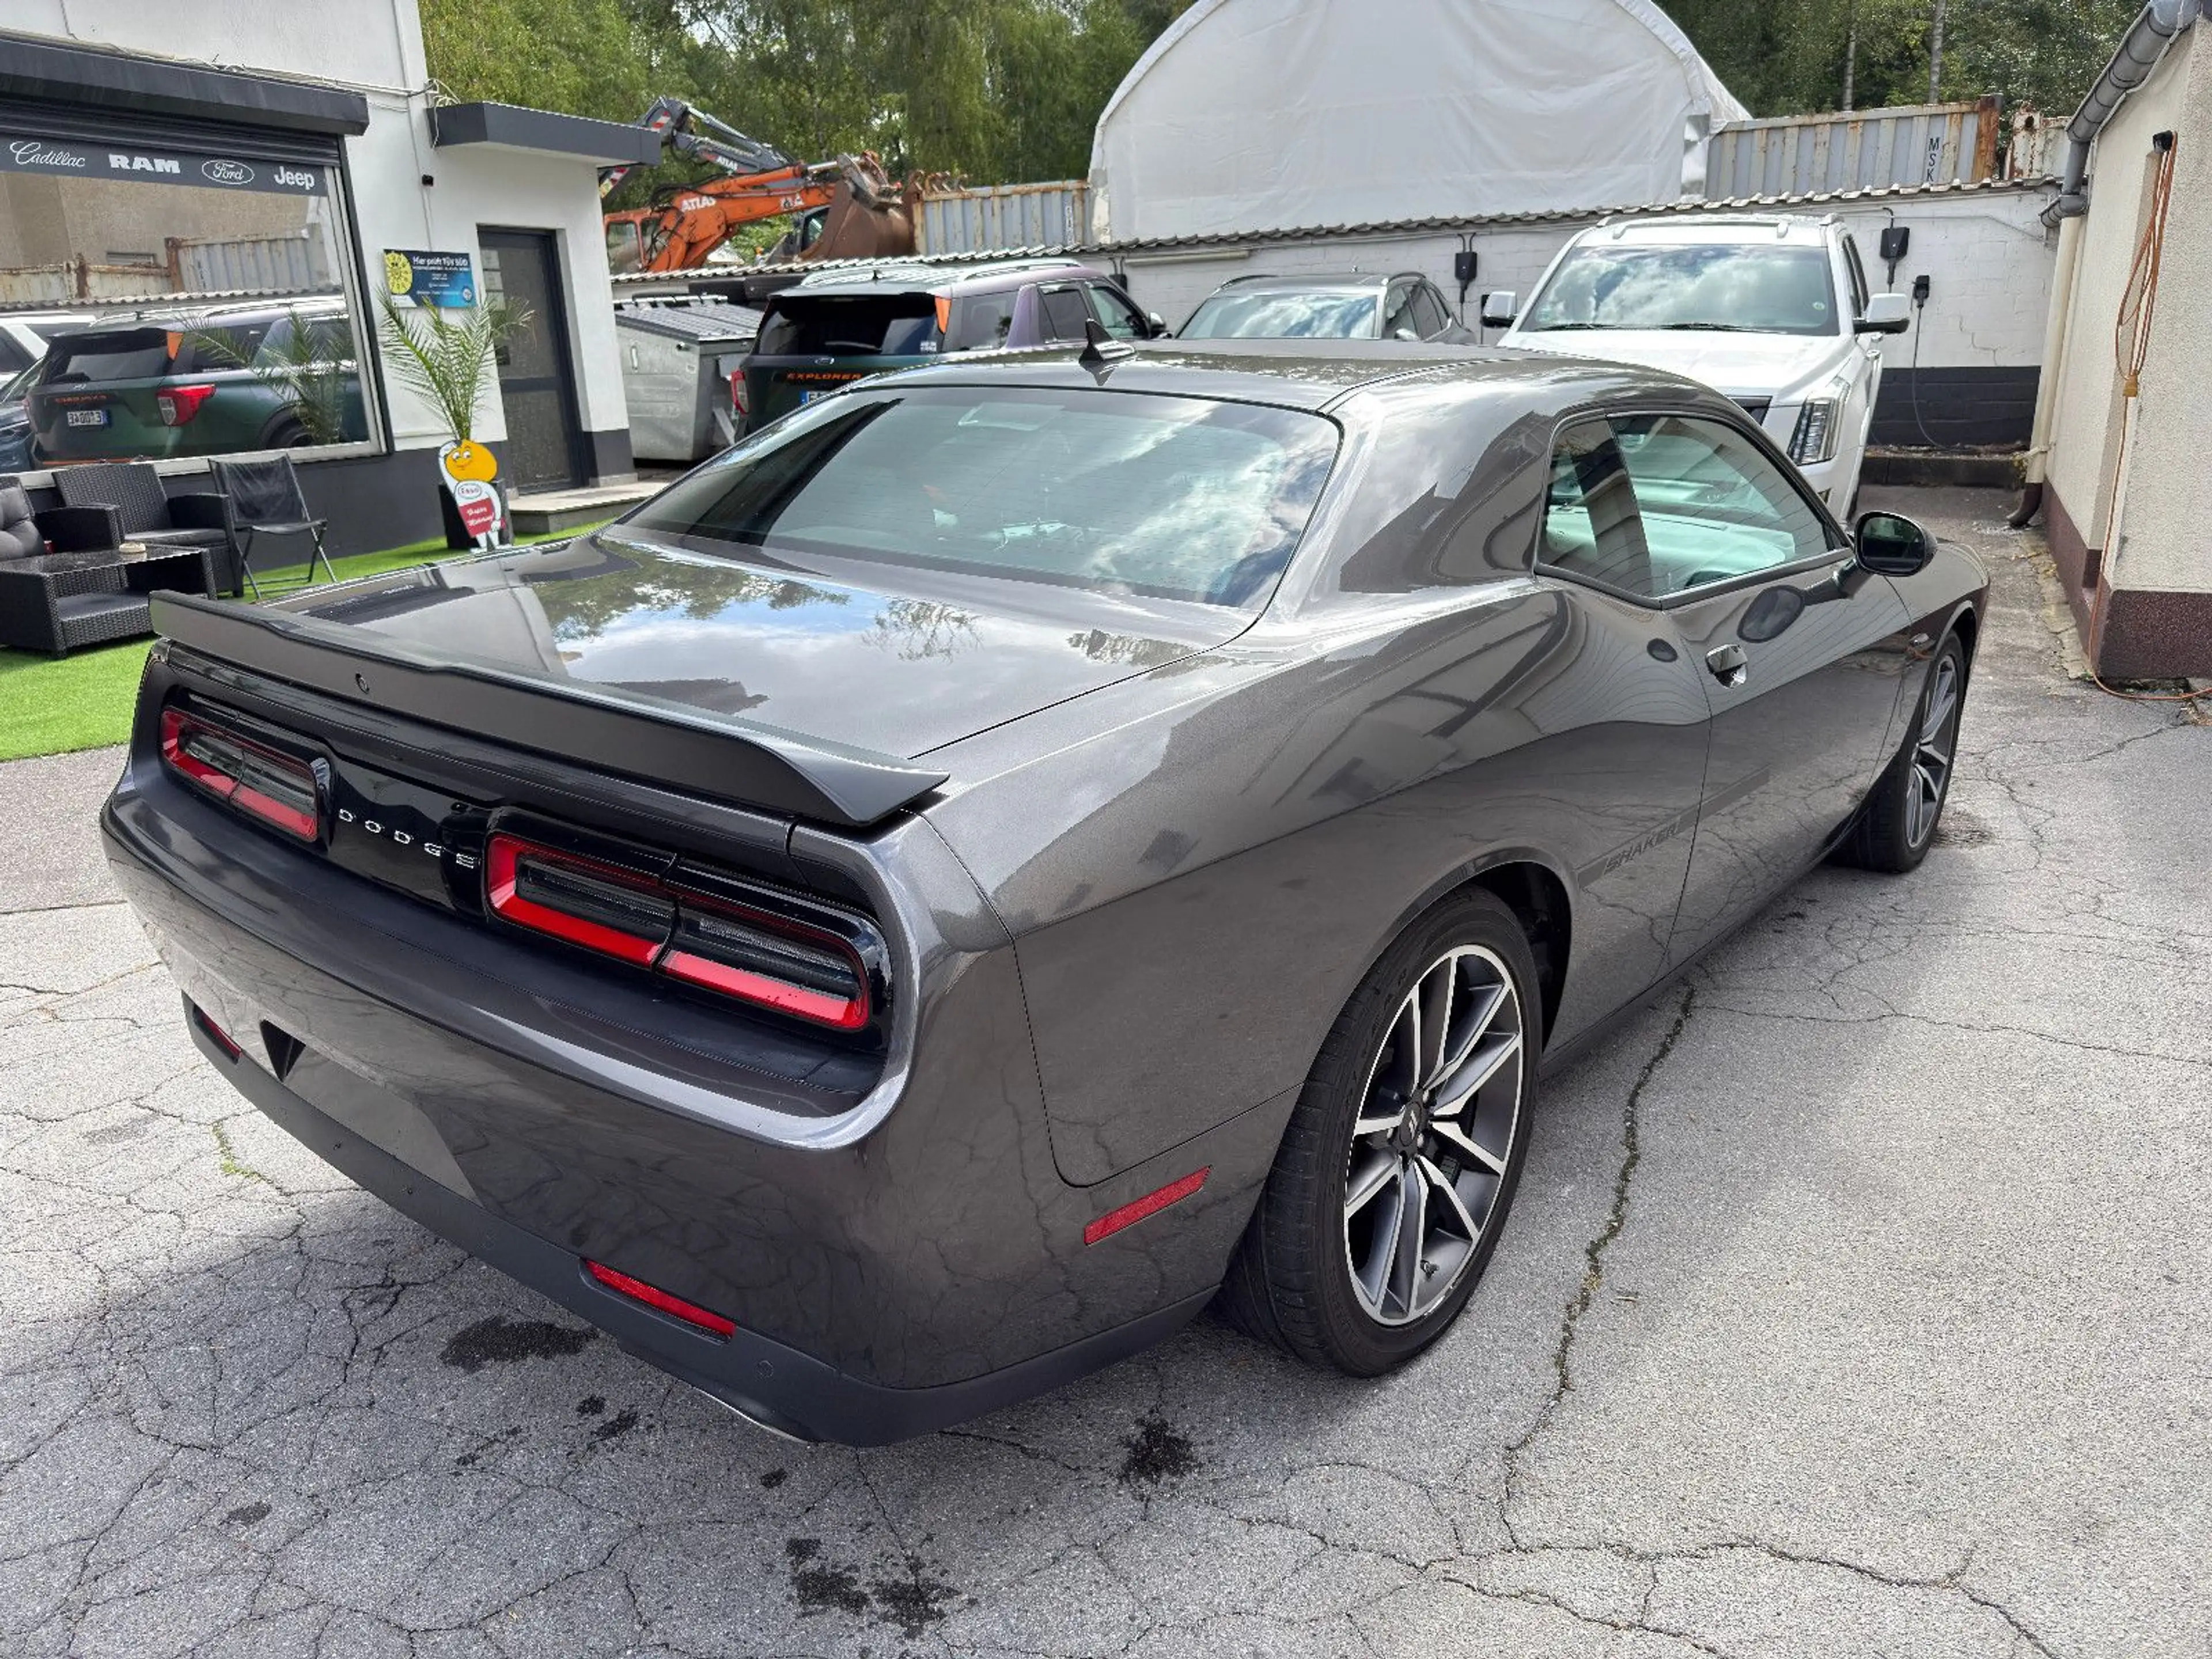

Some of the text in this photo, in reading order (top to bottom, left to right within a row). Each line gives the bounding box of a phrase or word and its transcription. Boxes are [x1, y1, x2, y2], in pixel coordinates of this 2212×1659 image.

[9, 141, 315, 190] Cadillac RAM Ford Jeep
[681, 196, 716, 211] ATLAS
[786, 372, 862, 381] EXPLORER
[338, 808, 475, 869] DODGE
